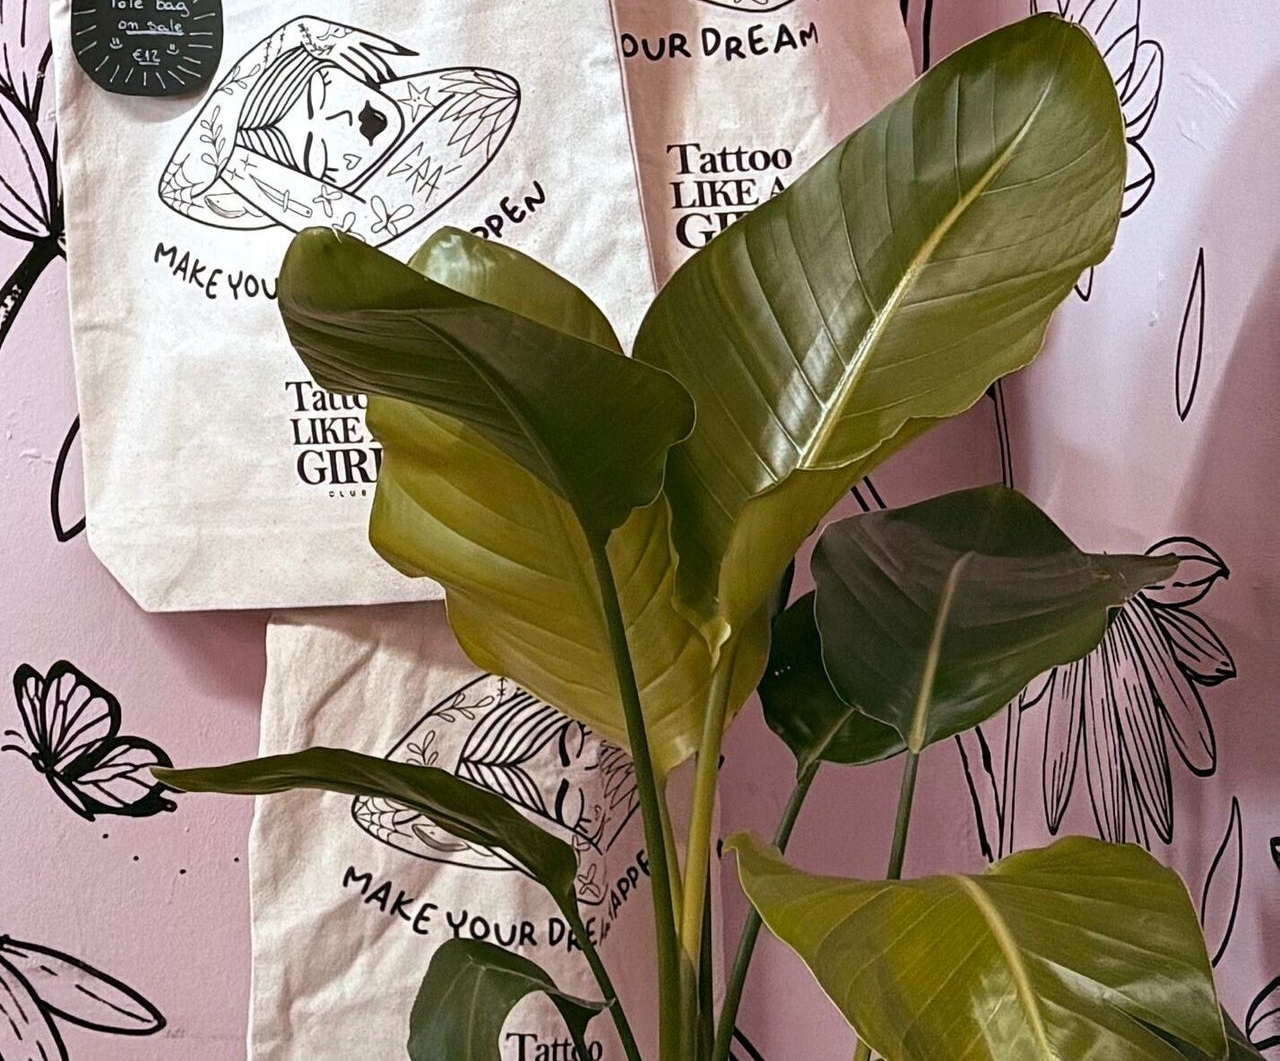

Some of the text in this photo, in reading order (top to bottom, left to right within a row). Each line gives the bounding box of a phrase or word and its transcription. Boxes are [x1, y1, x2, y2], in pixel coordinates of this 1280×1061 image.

[117, 18, 184, 36] on sale
[620, 21, 819, 62] OUR DREAM
[132, 48, 161, 66] €12
[666, 142, 793, 176] Tattoo
[669, 178, 760, 210] LIKE
[153, 242, 224, 300] MAKE
[227, 270, 280, 300] YOU
[284, 380, 369, 413] Tatto
[289, 416, 365, 446] LIKE
[342, 848, 652, 953] MAKE YOUR DRE APPE
